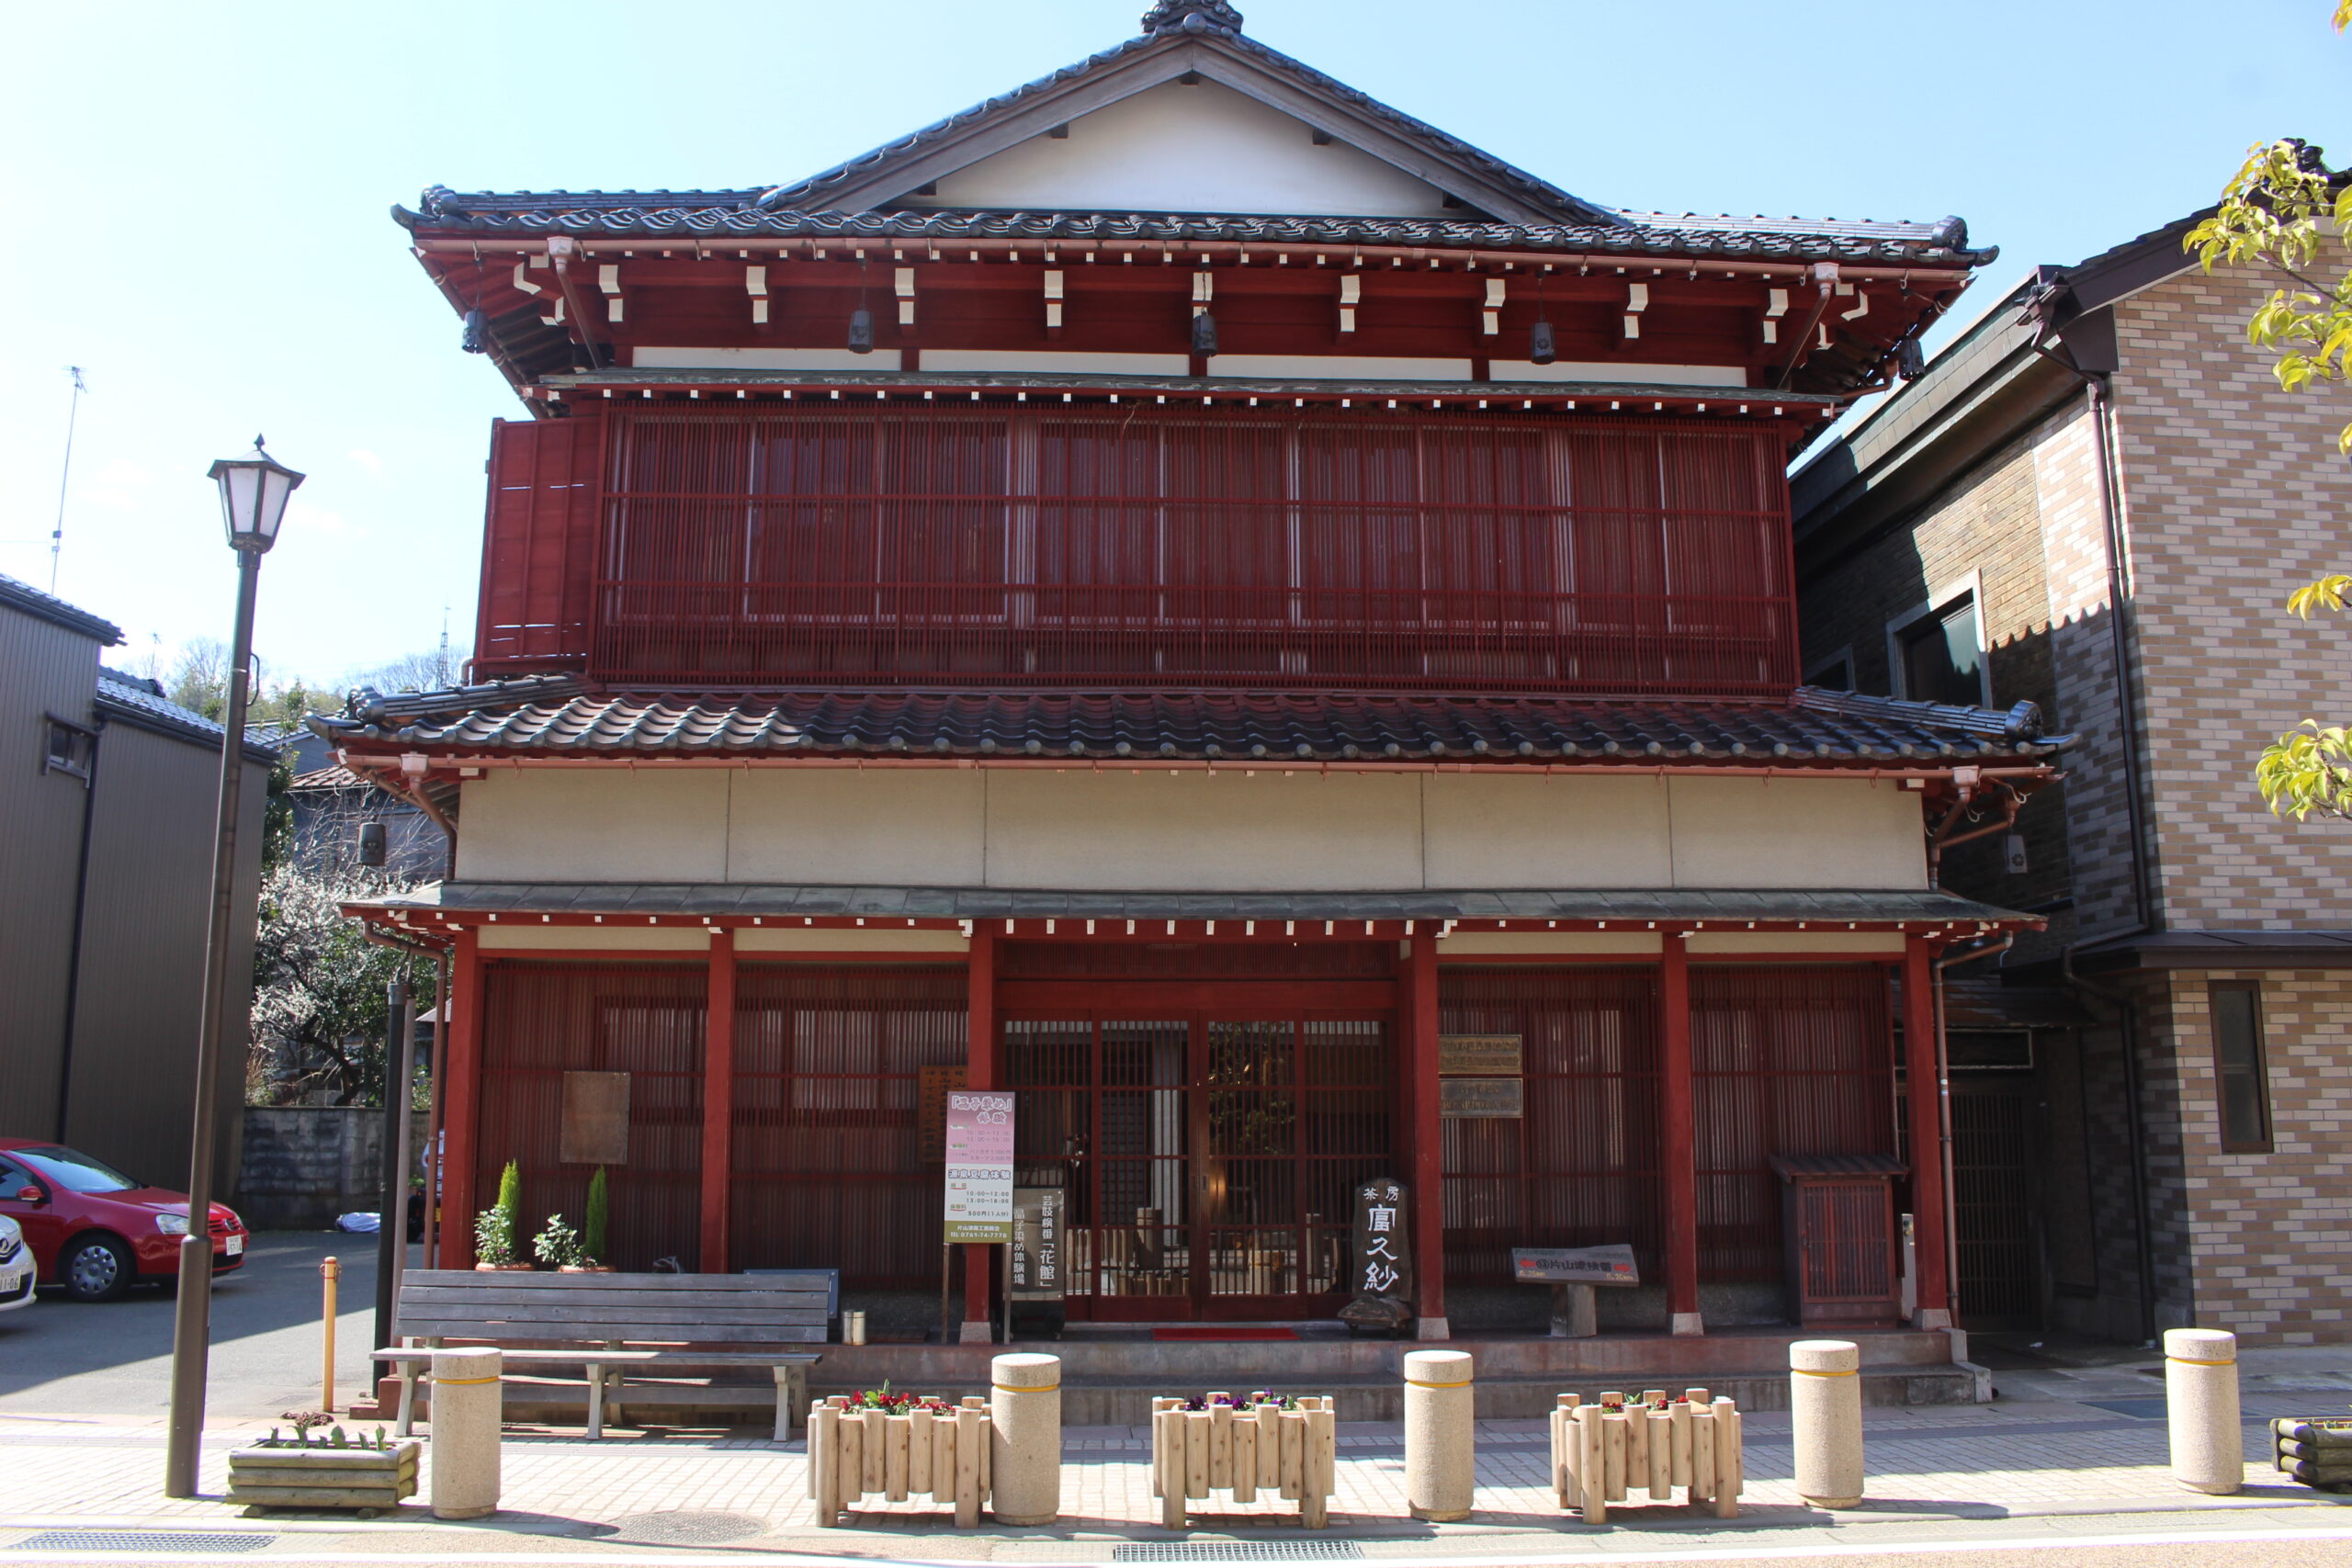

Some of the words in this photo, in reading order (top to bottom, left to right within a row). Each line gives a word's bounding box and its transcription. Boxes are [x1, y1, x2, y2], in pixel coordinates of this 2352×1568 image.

[1363, 1186, 1399, 1201] 茶房
[1363, 1203, 1399, 1292] 富久紗
